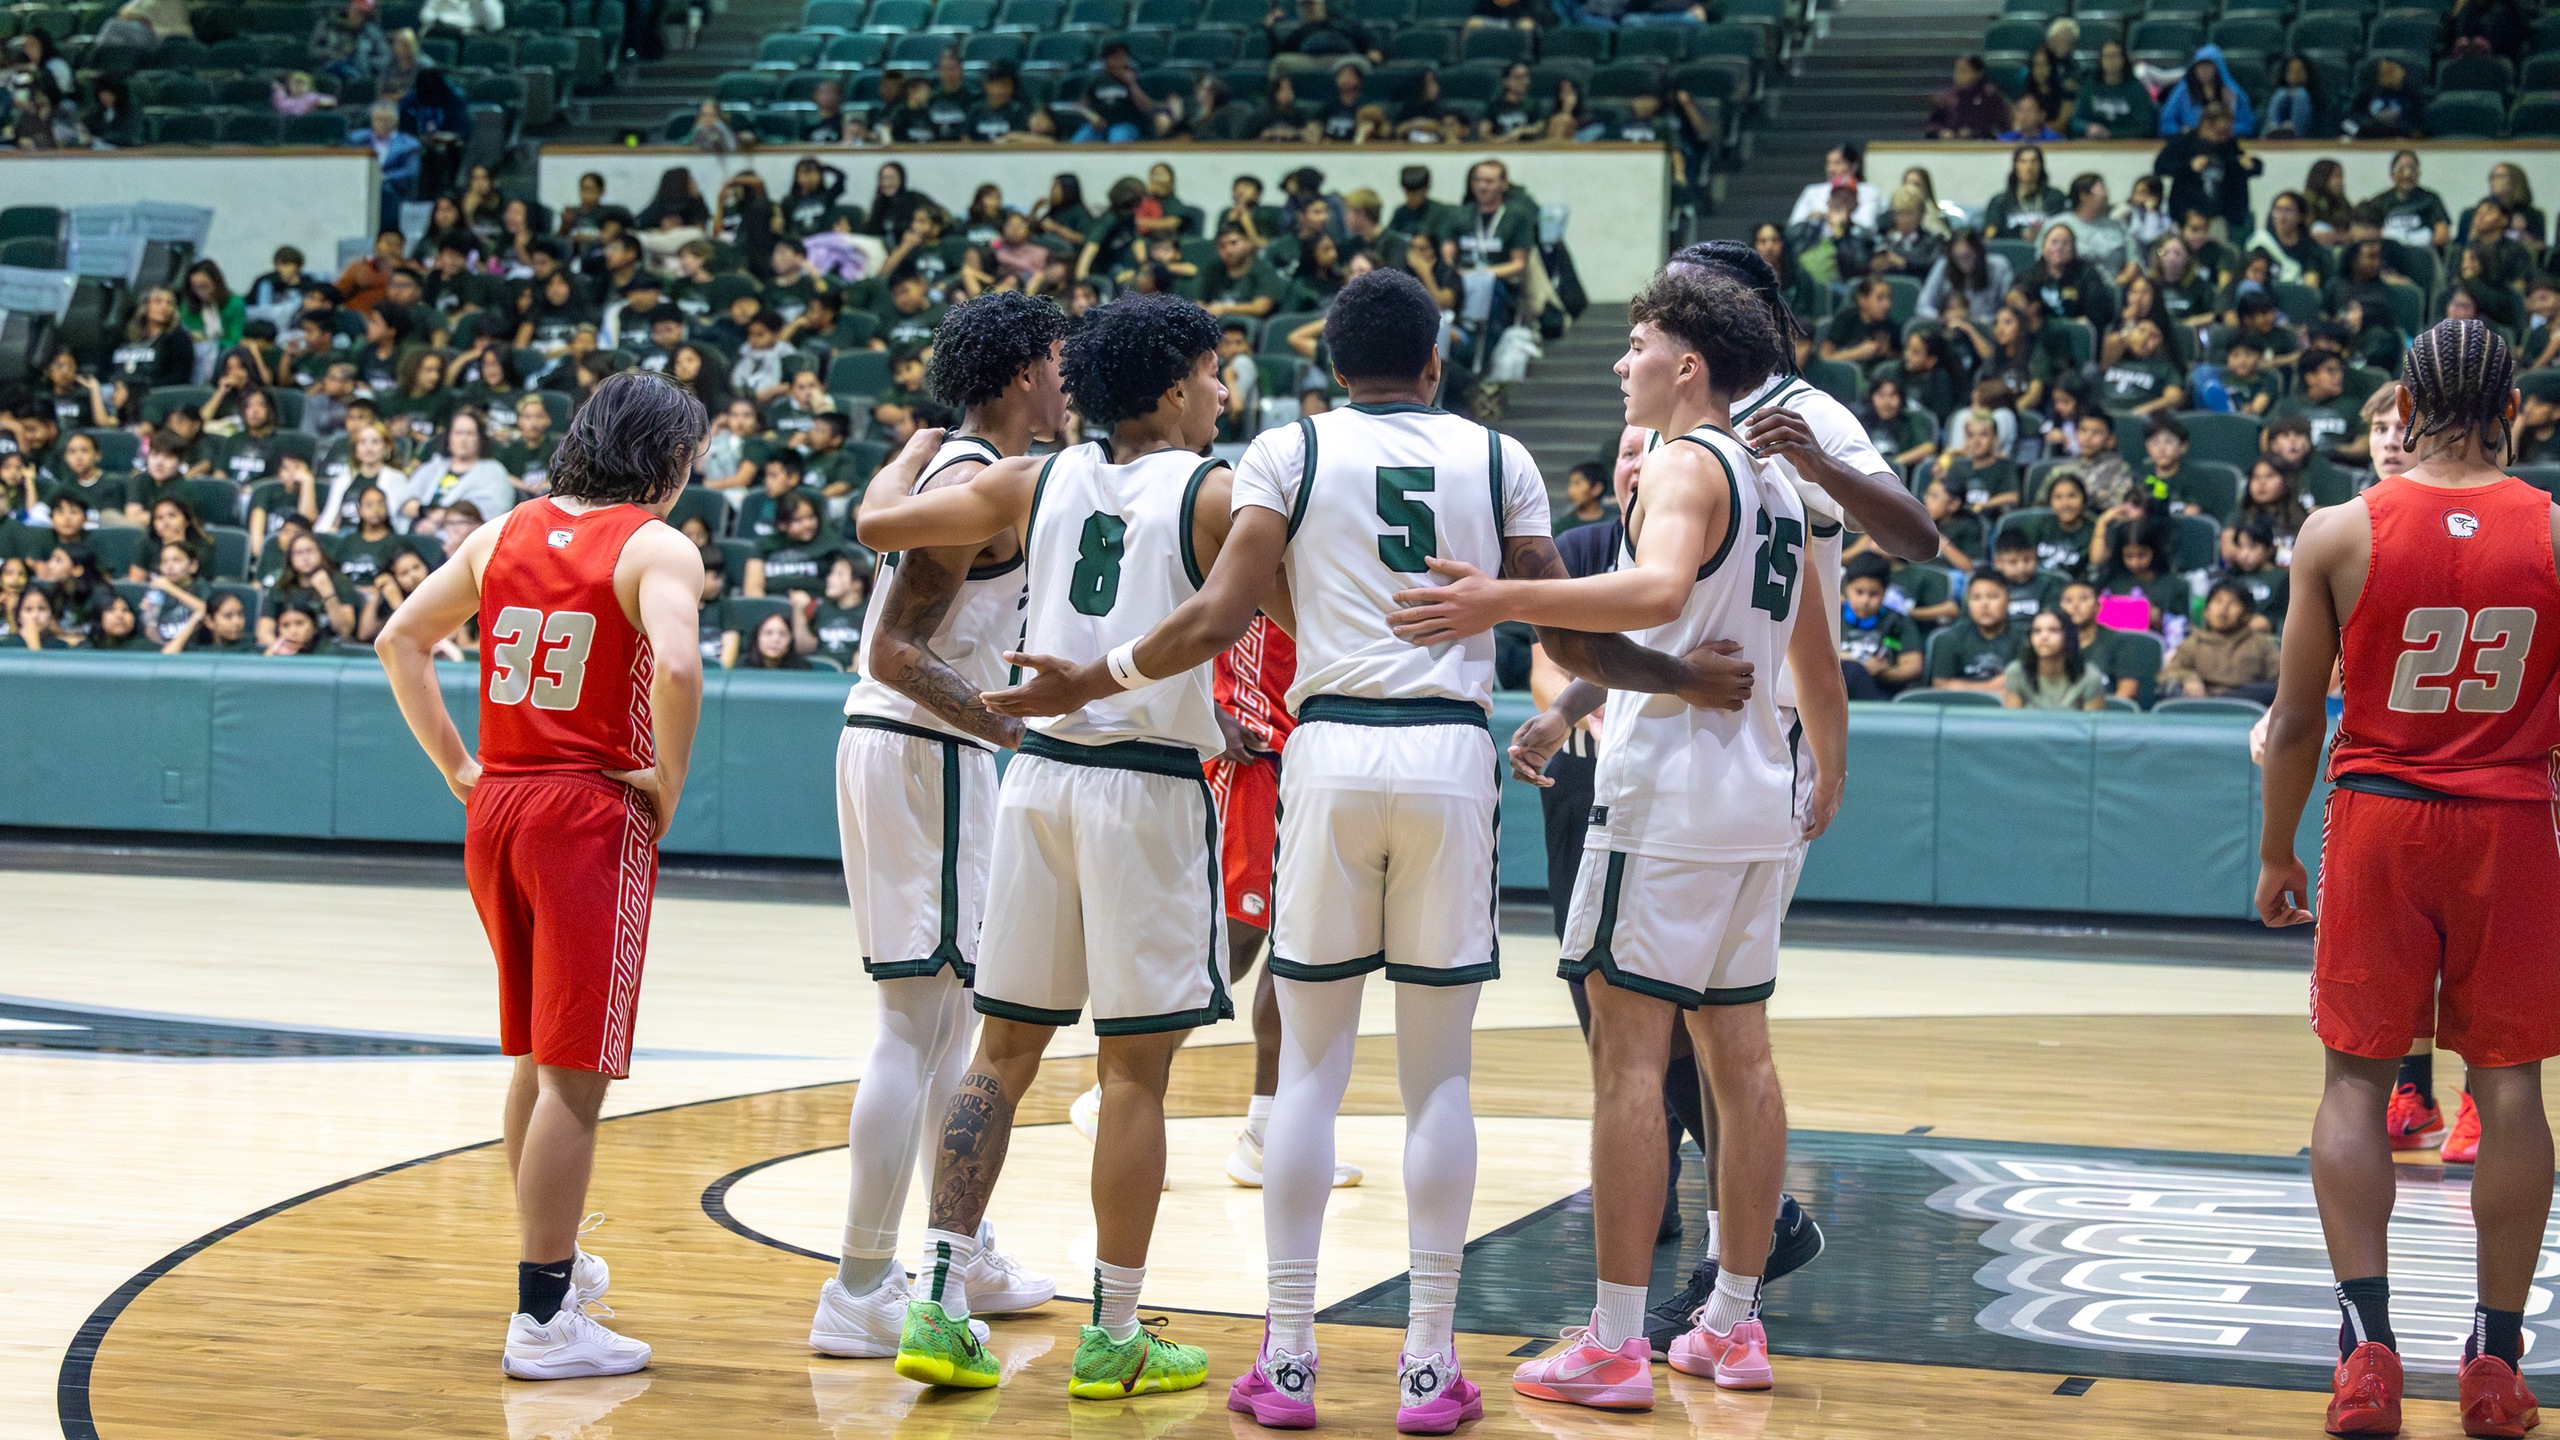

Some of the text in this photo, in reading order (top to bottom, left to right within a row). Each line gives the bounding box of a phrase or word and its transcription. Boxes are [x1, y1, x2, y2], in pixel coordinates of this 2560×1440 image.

[1068, 510, 1128, 617] 8
[1376, 465, 1437, 574] 5
[1751, 504, 1804, 623] 25
[489, 605, 597, 711] 33
[2387, 606, 2538, 714] 23
[950, 1092, 994, 1121] OURZ
[959, 1073, 998, 1096] OVE
